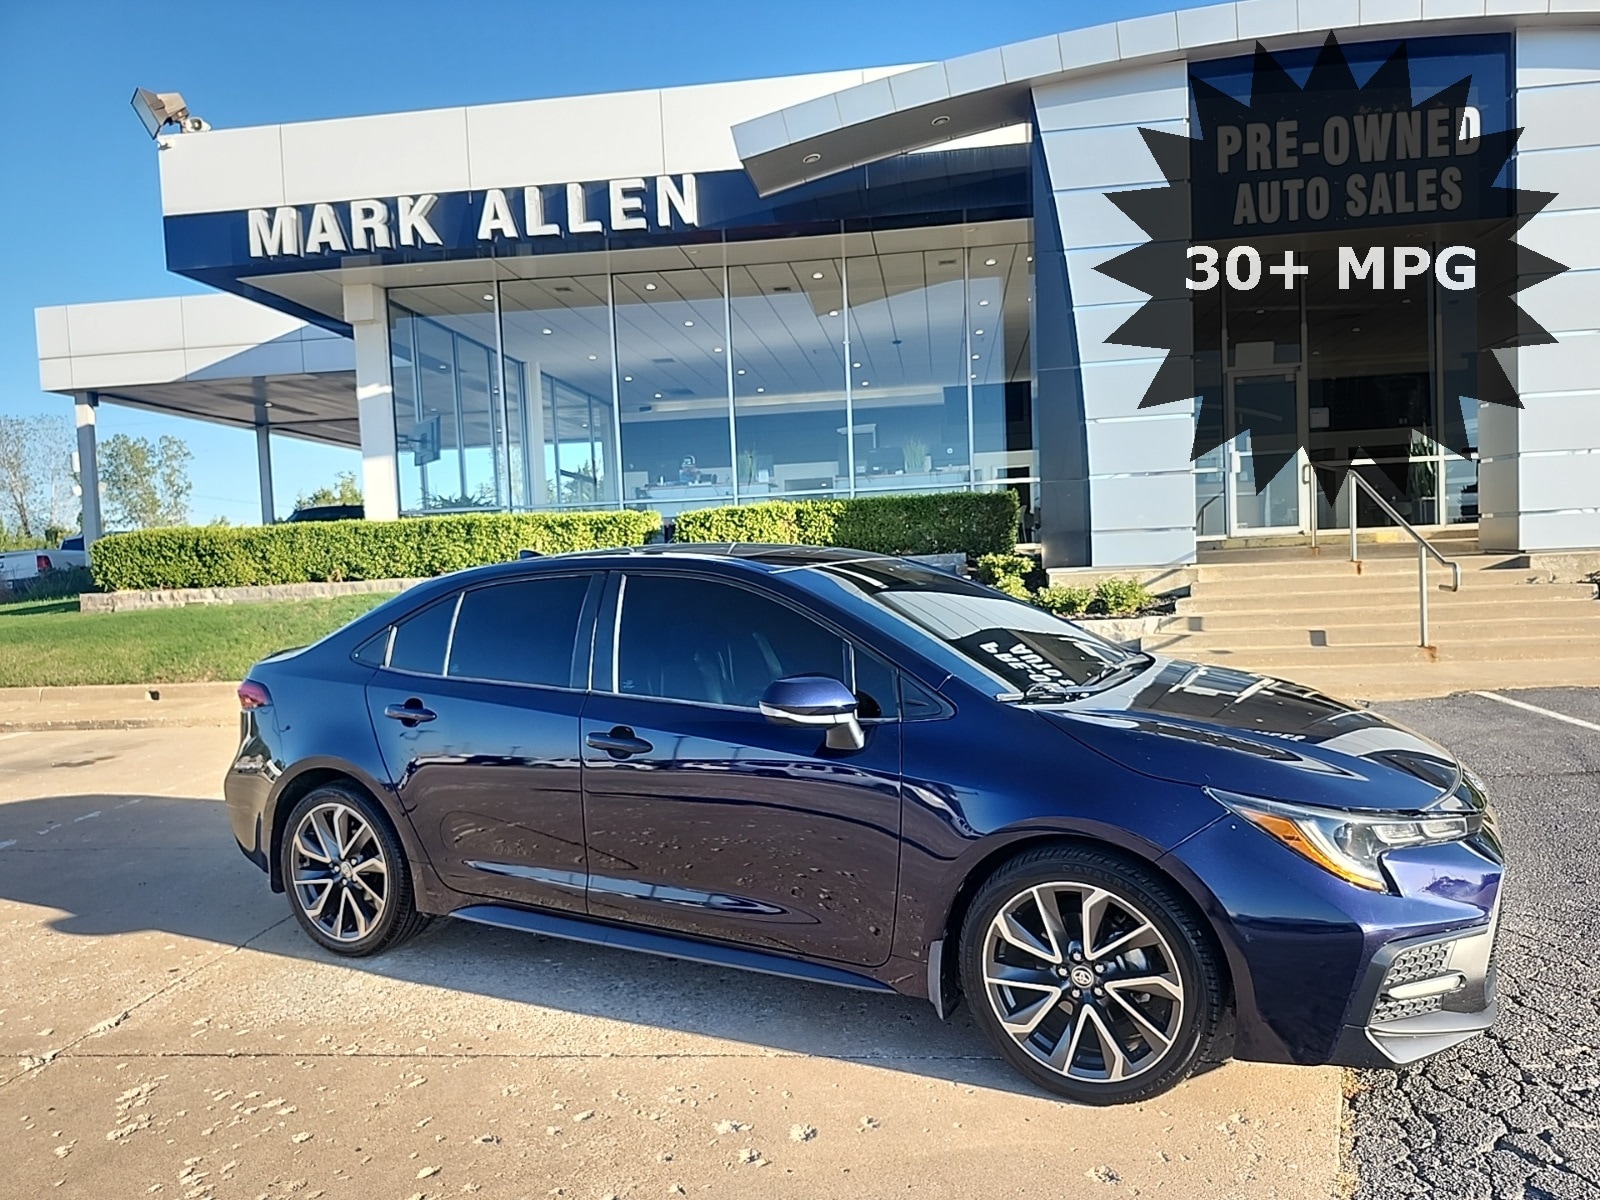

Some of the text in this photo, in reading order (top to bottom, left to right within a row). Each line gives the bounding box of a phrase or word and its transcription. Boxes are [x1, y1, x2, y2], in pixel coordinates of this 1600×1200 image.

[1217, 106, 1481, 174] PRE-OWNED
[247, 173, 700, 258] MARK ALLEN
[1232, 166, 1463, 226] AUTO SALES
[1062, 864, 1133, 890] CAVALRY
